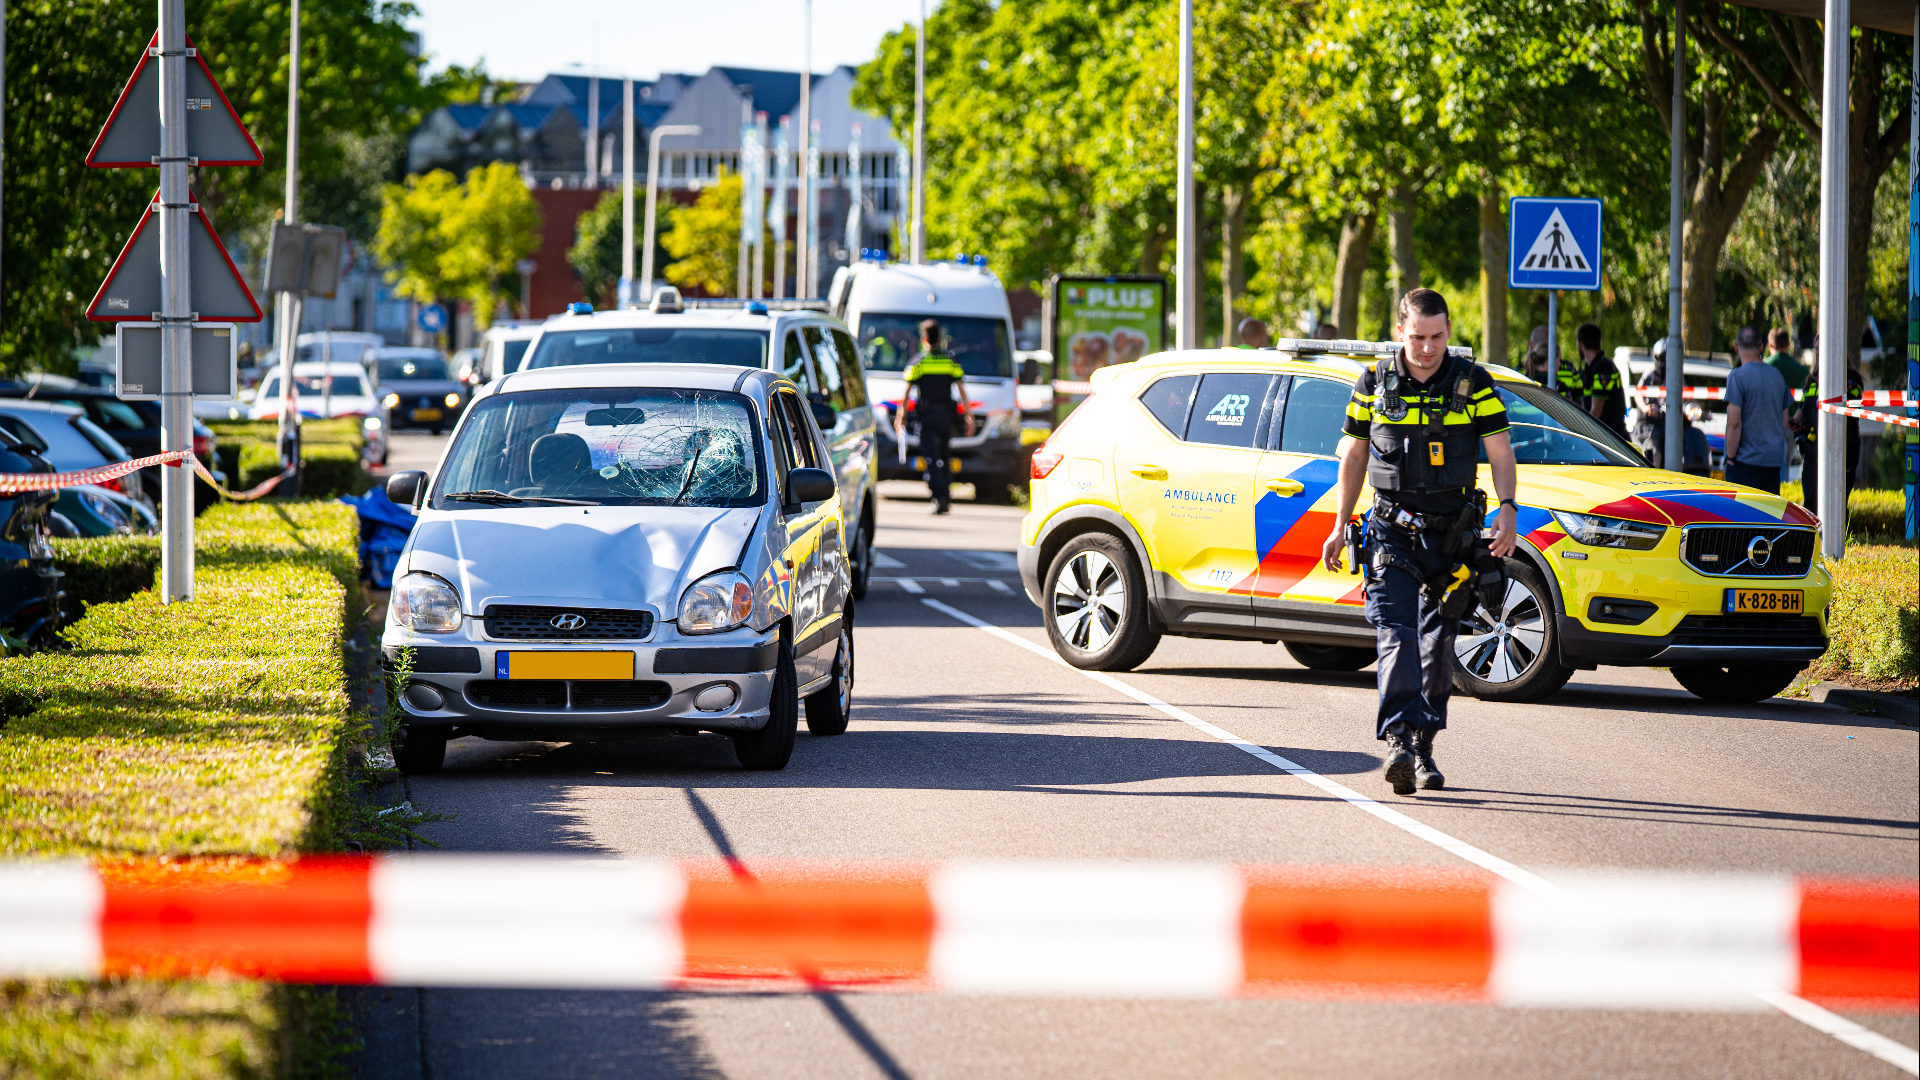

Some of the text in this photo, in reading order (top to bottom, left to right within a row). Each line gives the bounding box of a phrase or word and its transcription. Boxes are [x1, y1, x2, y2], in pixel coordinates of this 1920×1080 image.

[1087, 287, 1155, 309] PLUS
[1208, 394, 1250, 416] ARR
[1164, 489, 1237, 504] AMBULANCE
[1215, 570, 1233, 582] 112
[1738, 592, 1799, 610] K-828-BH
